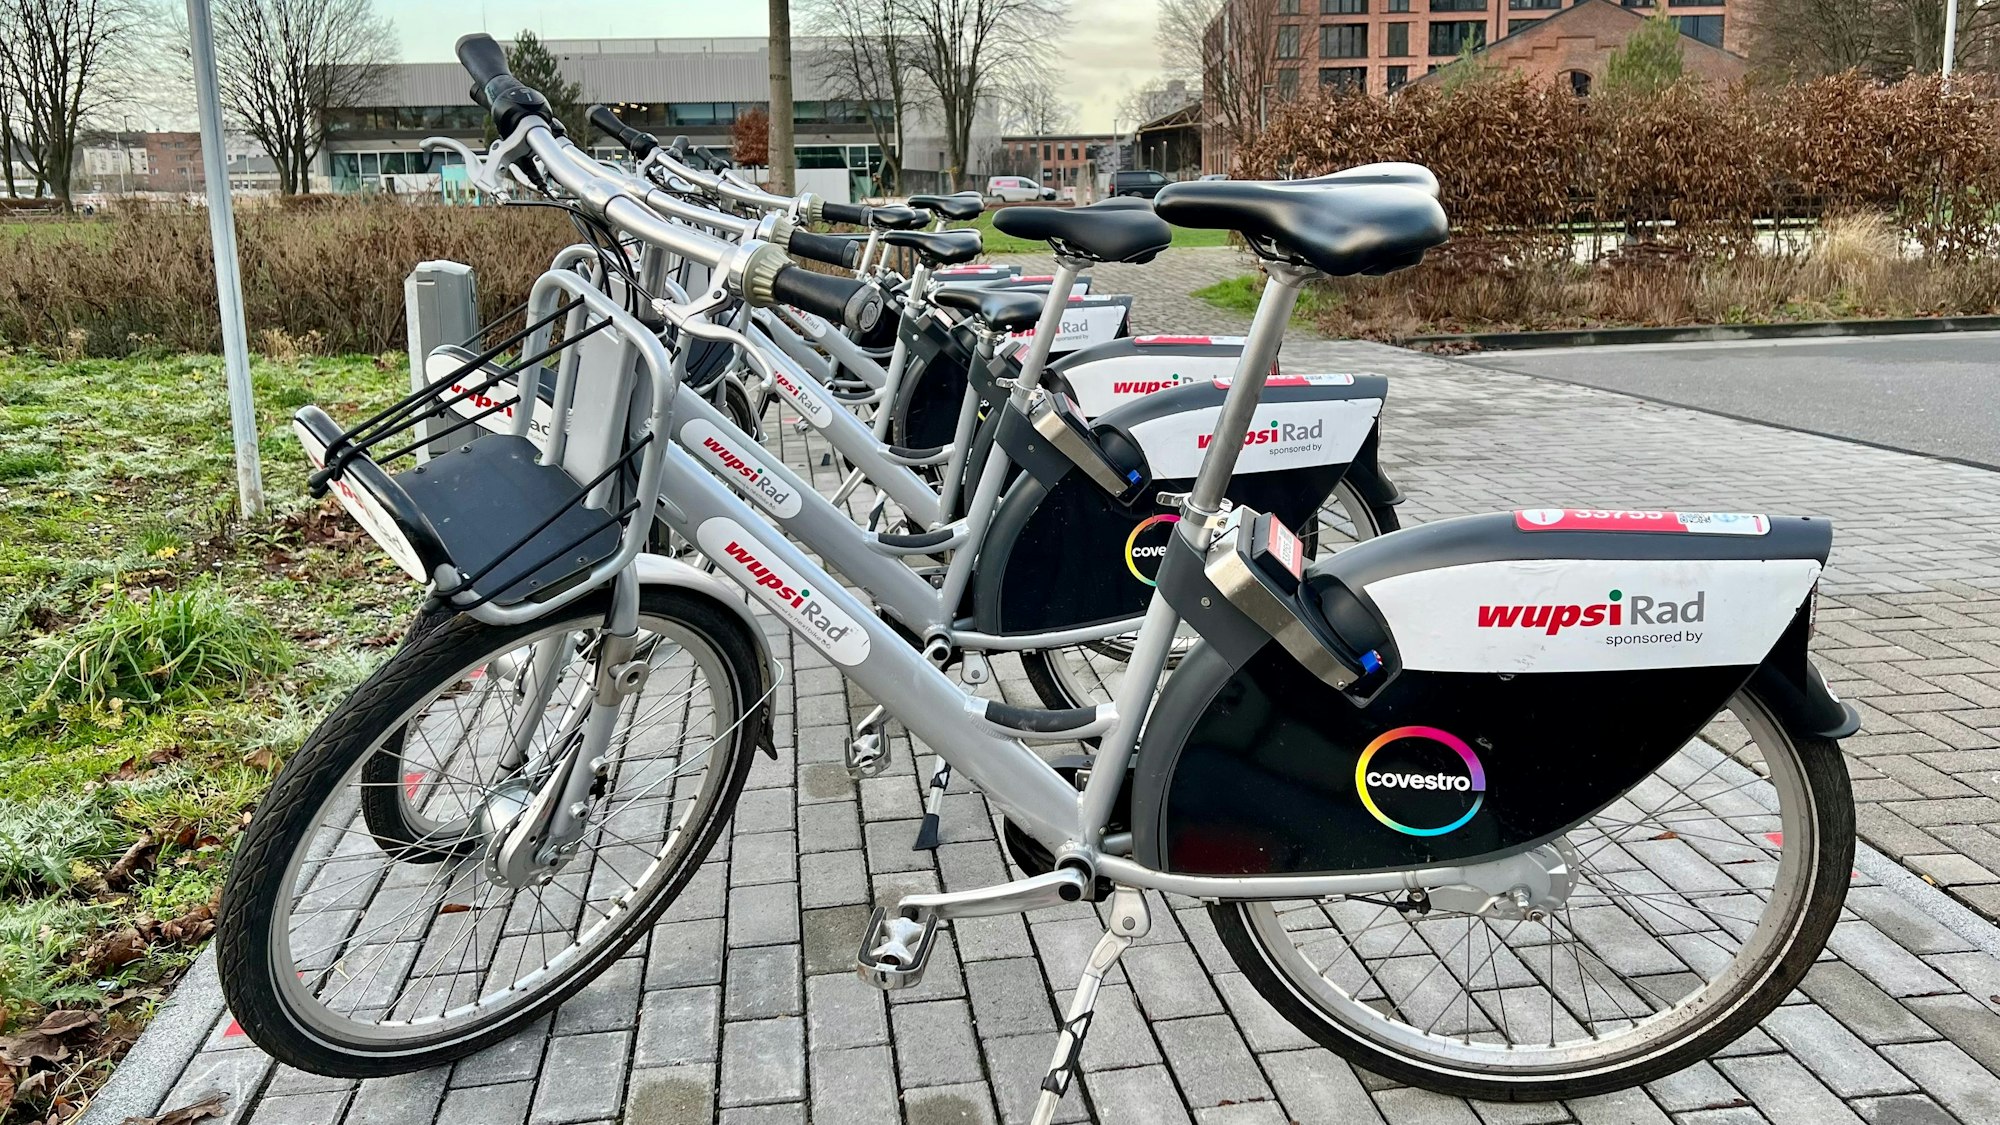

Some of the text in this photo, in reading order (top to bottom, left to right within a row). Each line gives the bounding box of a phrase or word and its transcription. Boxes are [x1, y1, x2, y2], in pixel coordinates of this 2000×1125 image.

[1062, 319, 1089, 334] Rad
[798, 392, 822, 415] Rad
[1282, 418, 1323, 442] Rad
[1269, 442, 1322, 456] sponsored by
[703, 437, 763, 483] wupsi
[755, 476, 790, 505] Rad
[1131, 545, 1167, 558] cove
[724, 541, 849, 643] wupsi Rad
[1478, 589, 1705, 636] wupsi Rad
[1606, 630, 1703, 647] sponsored by
[1366, 771, 1471, 792] covestro
